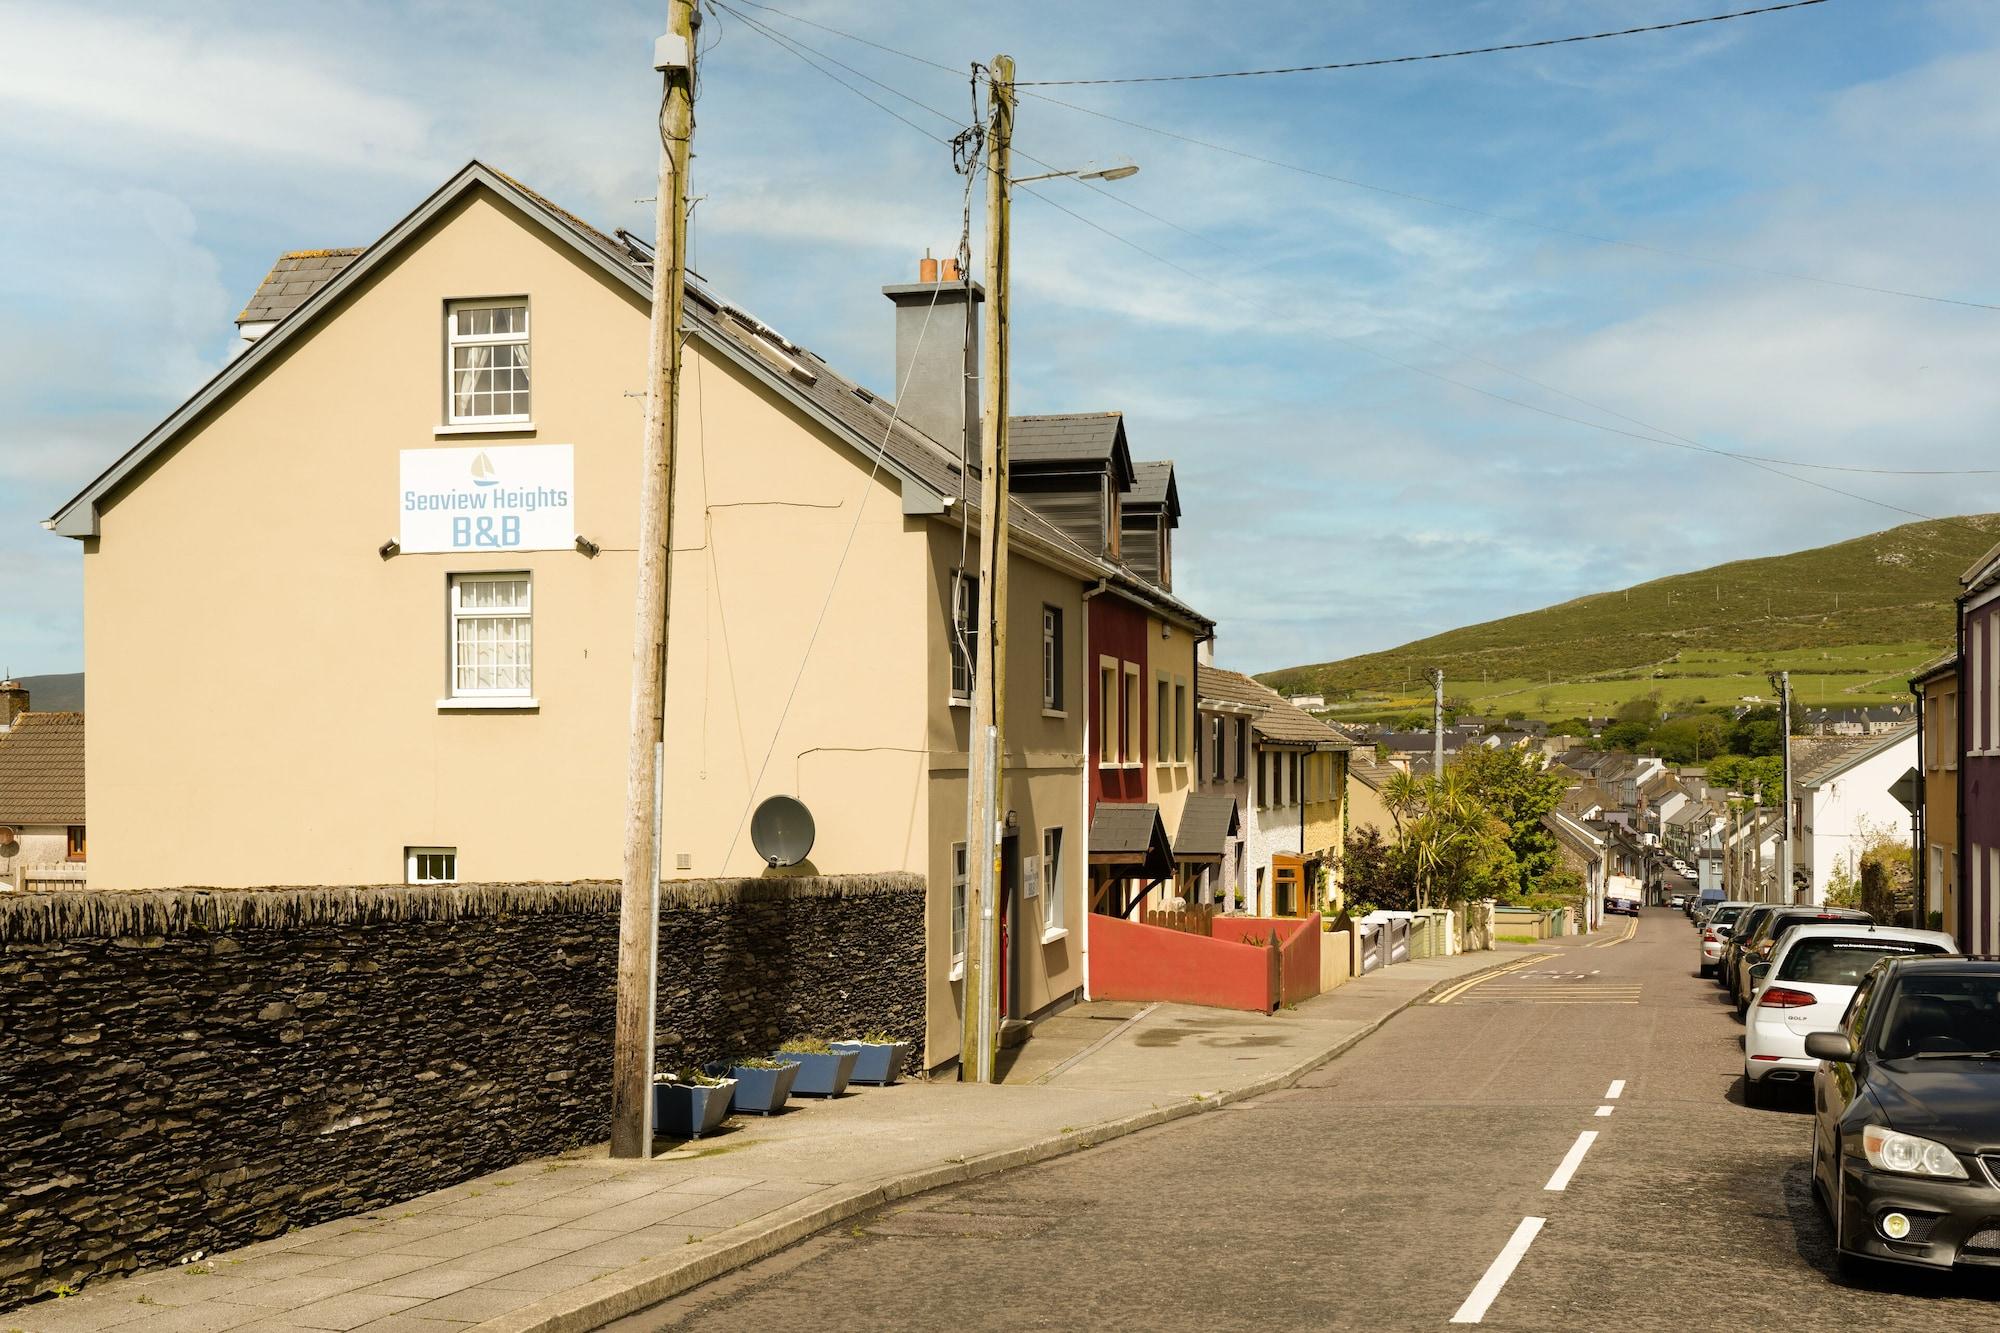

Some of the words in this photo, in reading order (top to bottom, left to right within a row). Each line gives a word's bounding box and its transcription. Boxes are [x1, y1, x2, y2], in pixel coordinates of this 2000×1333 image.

[405, 488, 487, 511] Seaview
[493, 486, 568, 512] Heights
[452, 515, 521, 548] B&B
